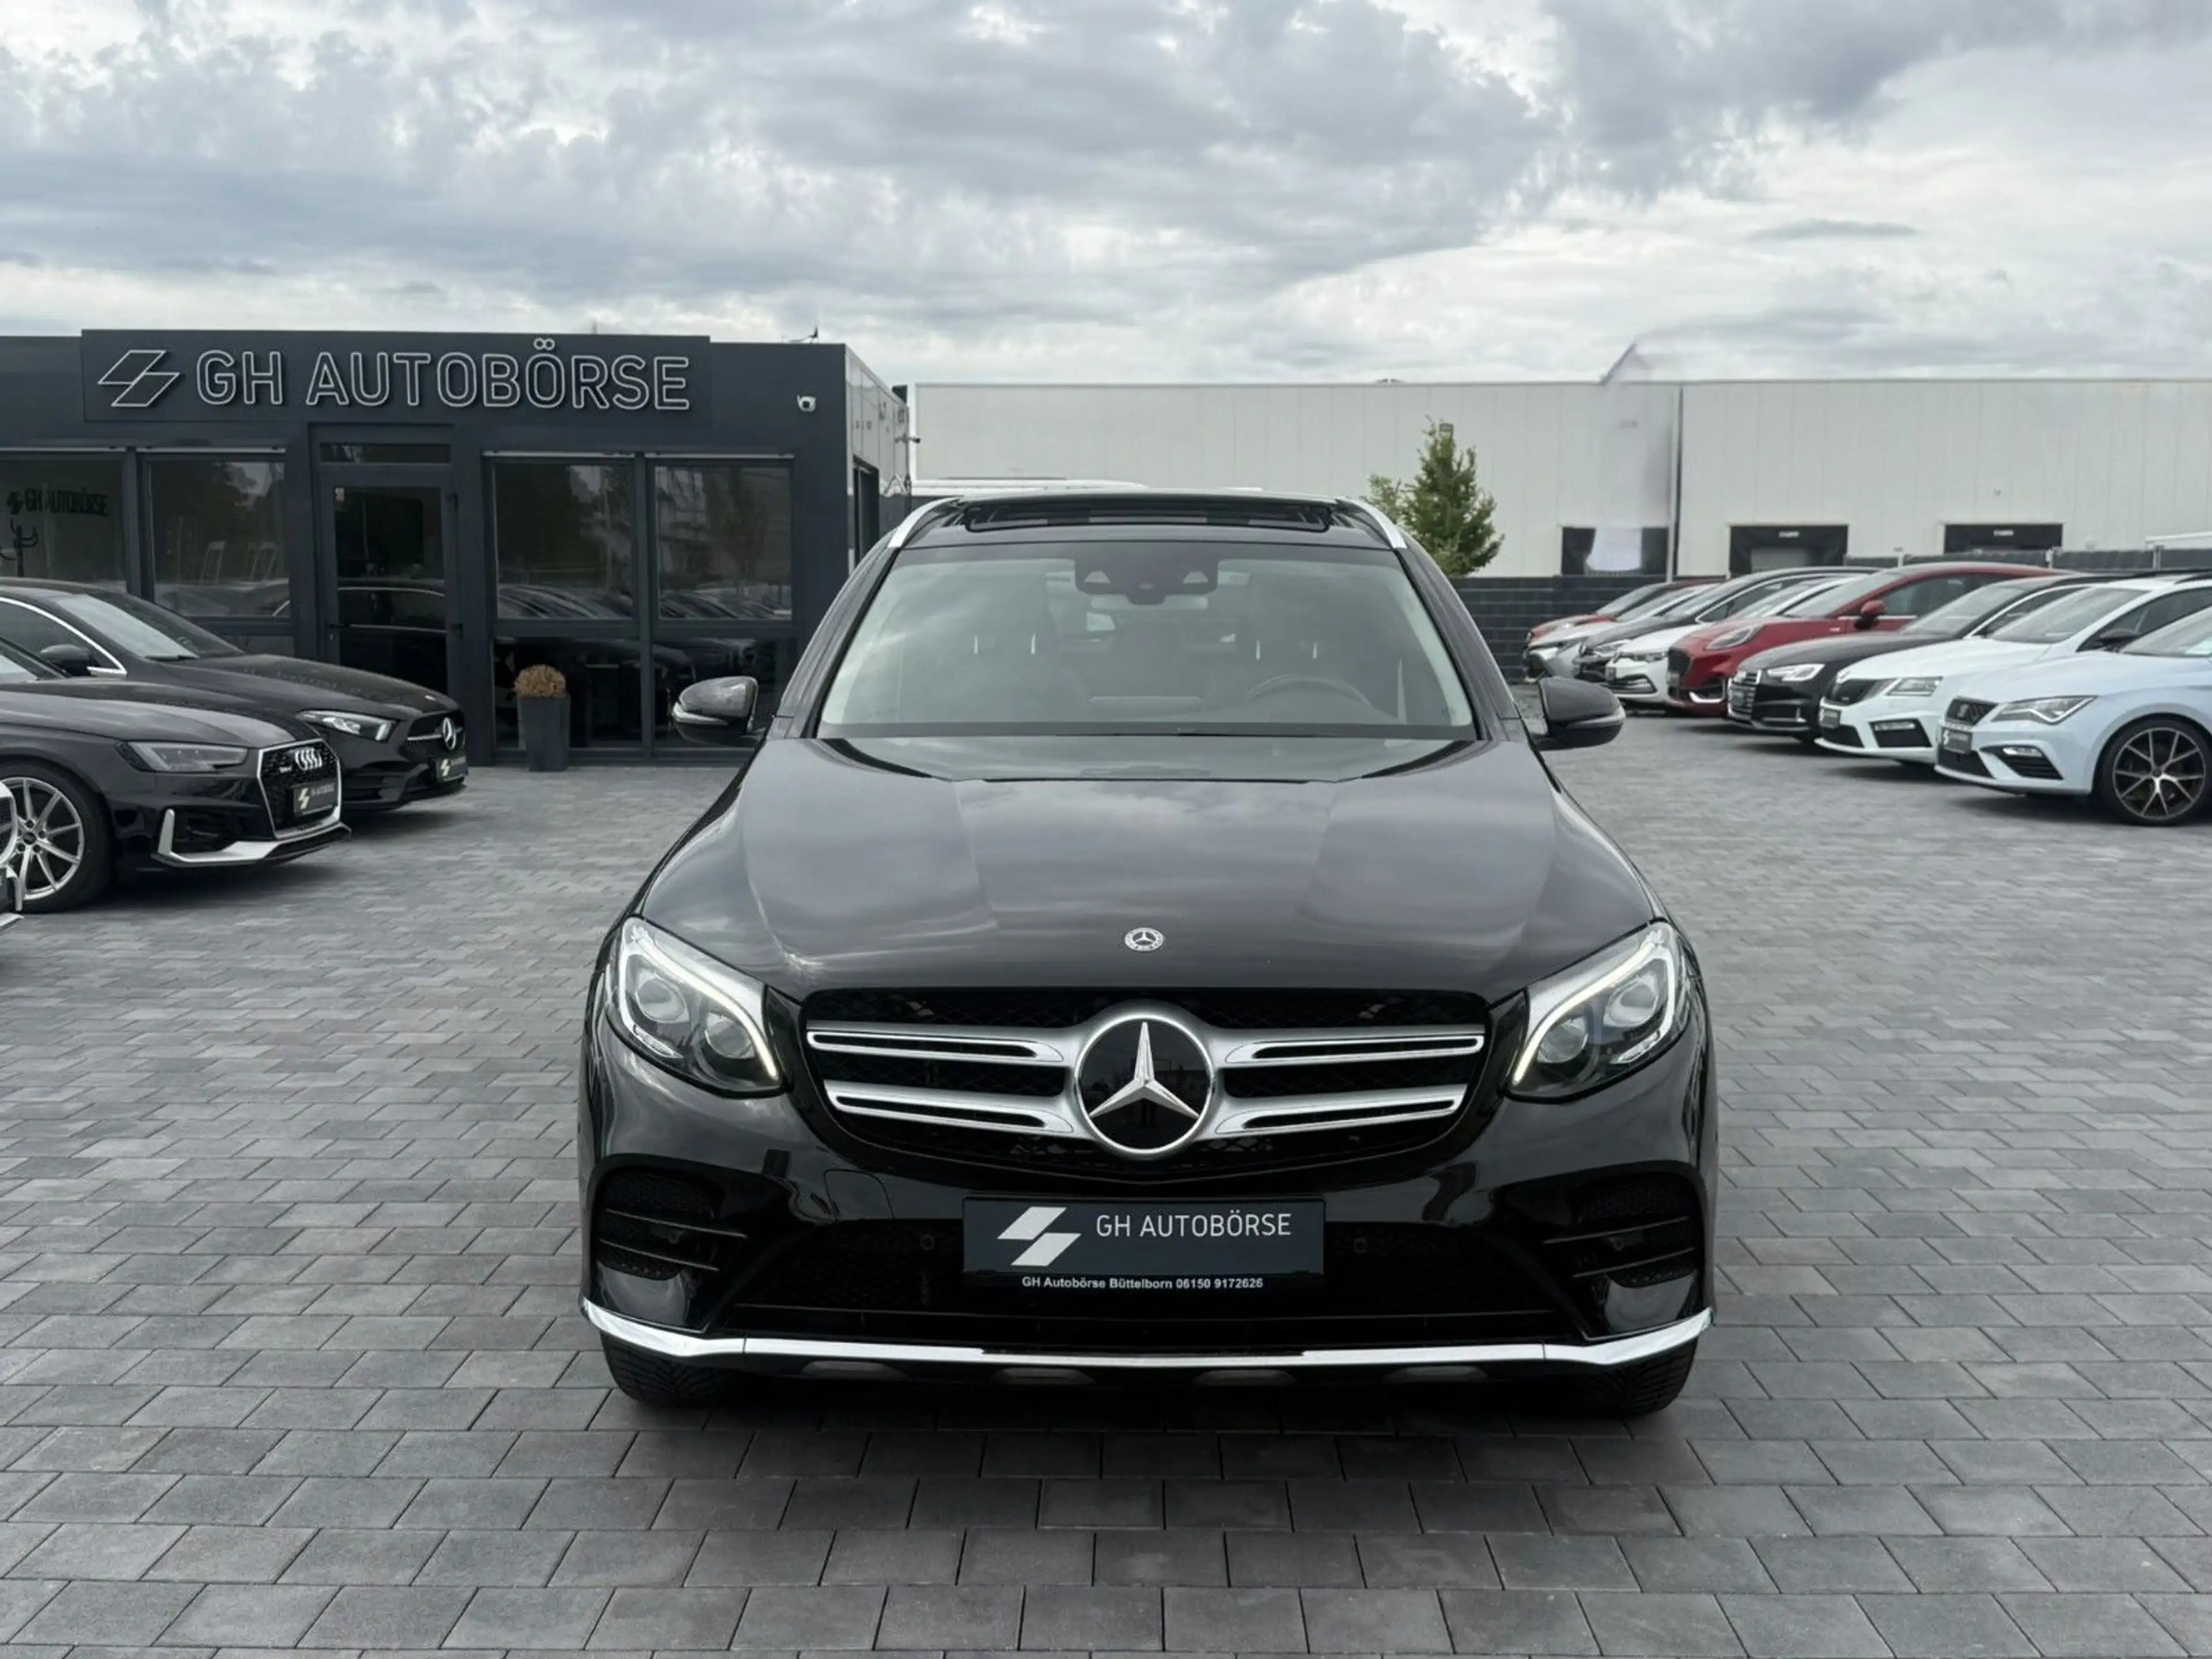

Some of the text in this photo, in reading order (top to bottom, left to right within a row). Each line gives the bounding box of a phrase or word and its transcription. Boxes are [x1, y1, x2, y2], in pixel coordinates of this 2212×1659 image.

[196, 337, 690, 410] GH AUTOBÖRSE
[1096, 1210, 1291, 1237] GH AUTOBÖRSE
[1022, 1276, 1263, 1289] GH Autobörse Büttelborn 06150 9172626
